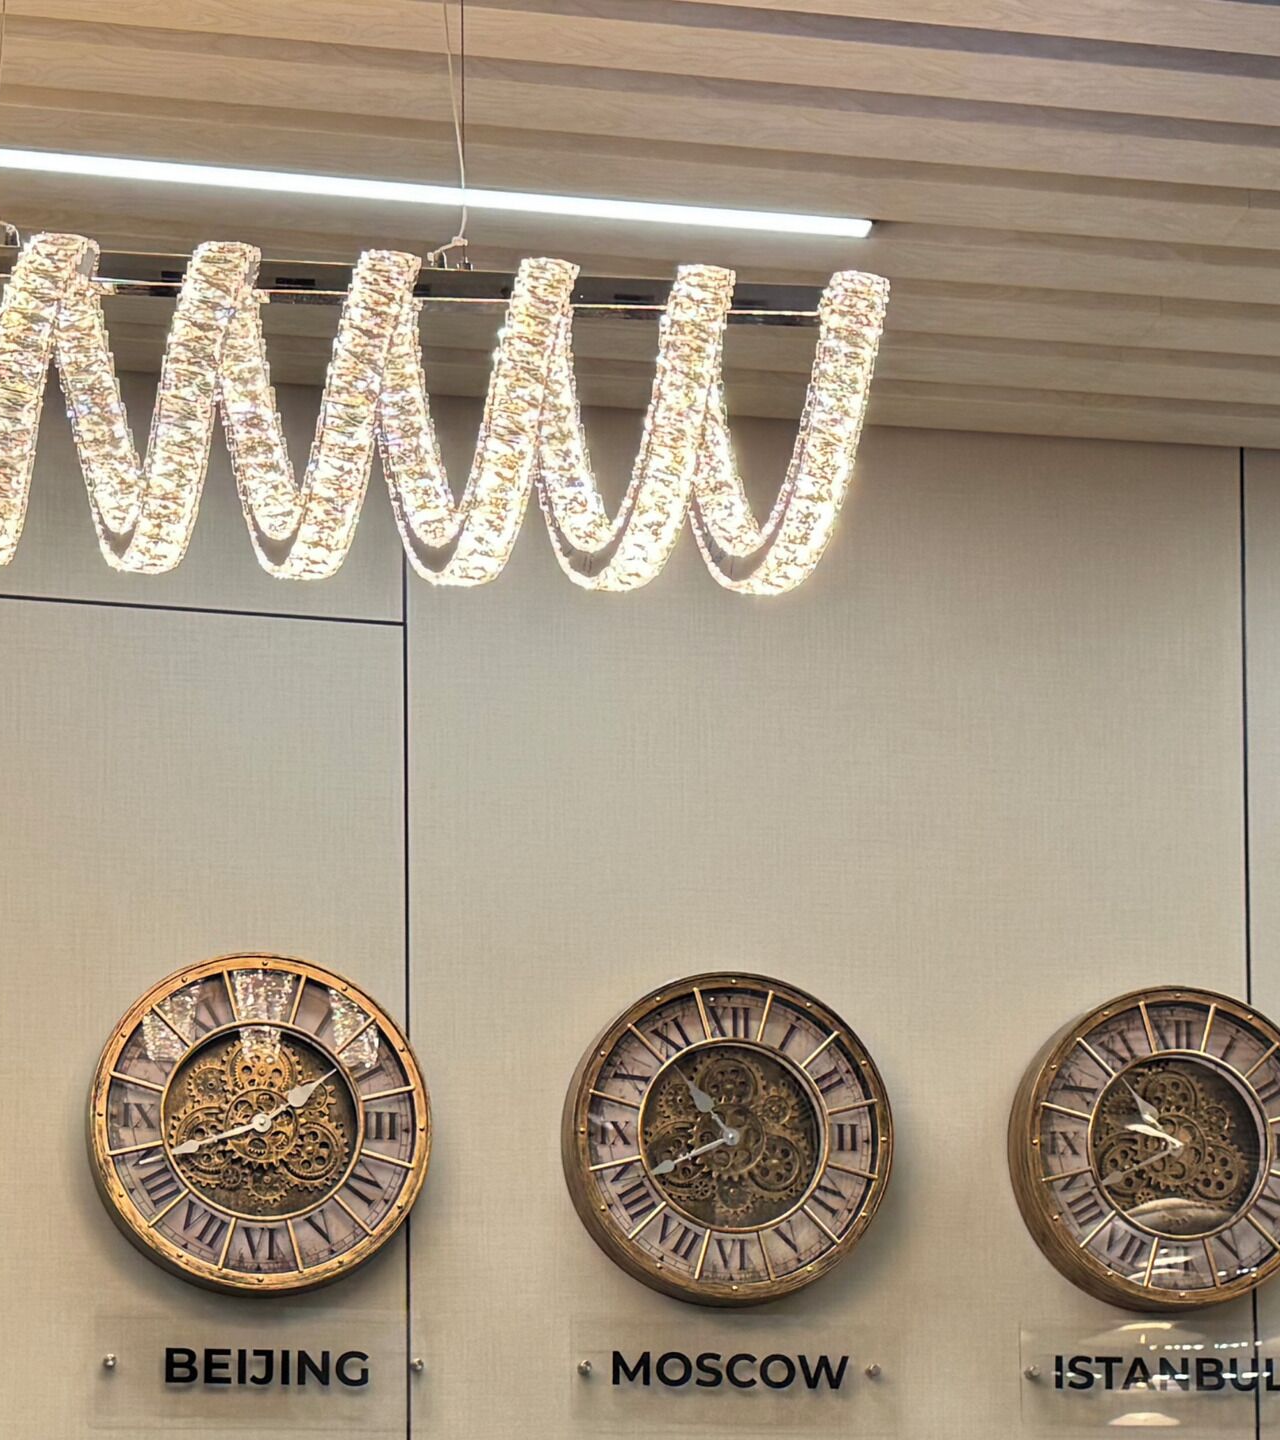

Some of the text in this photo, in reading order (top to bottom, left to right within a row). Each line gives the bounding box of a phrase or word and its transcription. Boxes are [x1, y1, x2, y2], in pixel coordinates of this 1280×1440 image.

[650, 1016, 694, 1060] XI
[707, 1005, 751, 1039] XII
[612, 1059, 652, 1095] X
[814, 1066, 846, 1095] II
[122, 1103, 156, 1129] IX
[599, 1120, 632, 1146] IX
[1049, 1131, 1080, 1156] IX
[610, 1163, 658, 1220] VIII
[183, 1199, 229, 1248] VII
[304, 1208, 332, 1244] V
[659, 1213, 703, 1260] VII
[772, 1220, 800, 1253] V
[242, 1227, 276, 1260] VI
[714, 1239, 747, 1270] VI
[1106, 1222, 1147, 1264] VII
[165, 1347, 369, 1387] BEIJING
[612, 1351, 850, 1390] MOSCOW
